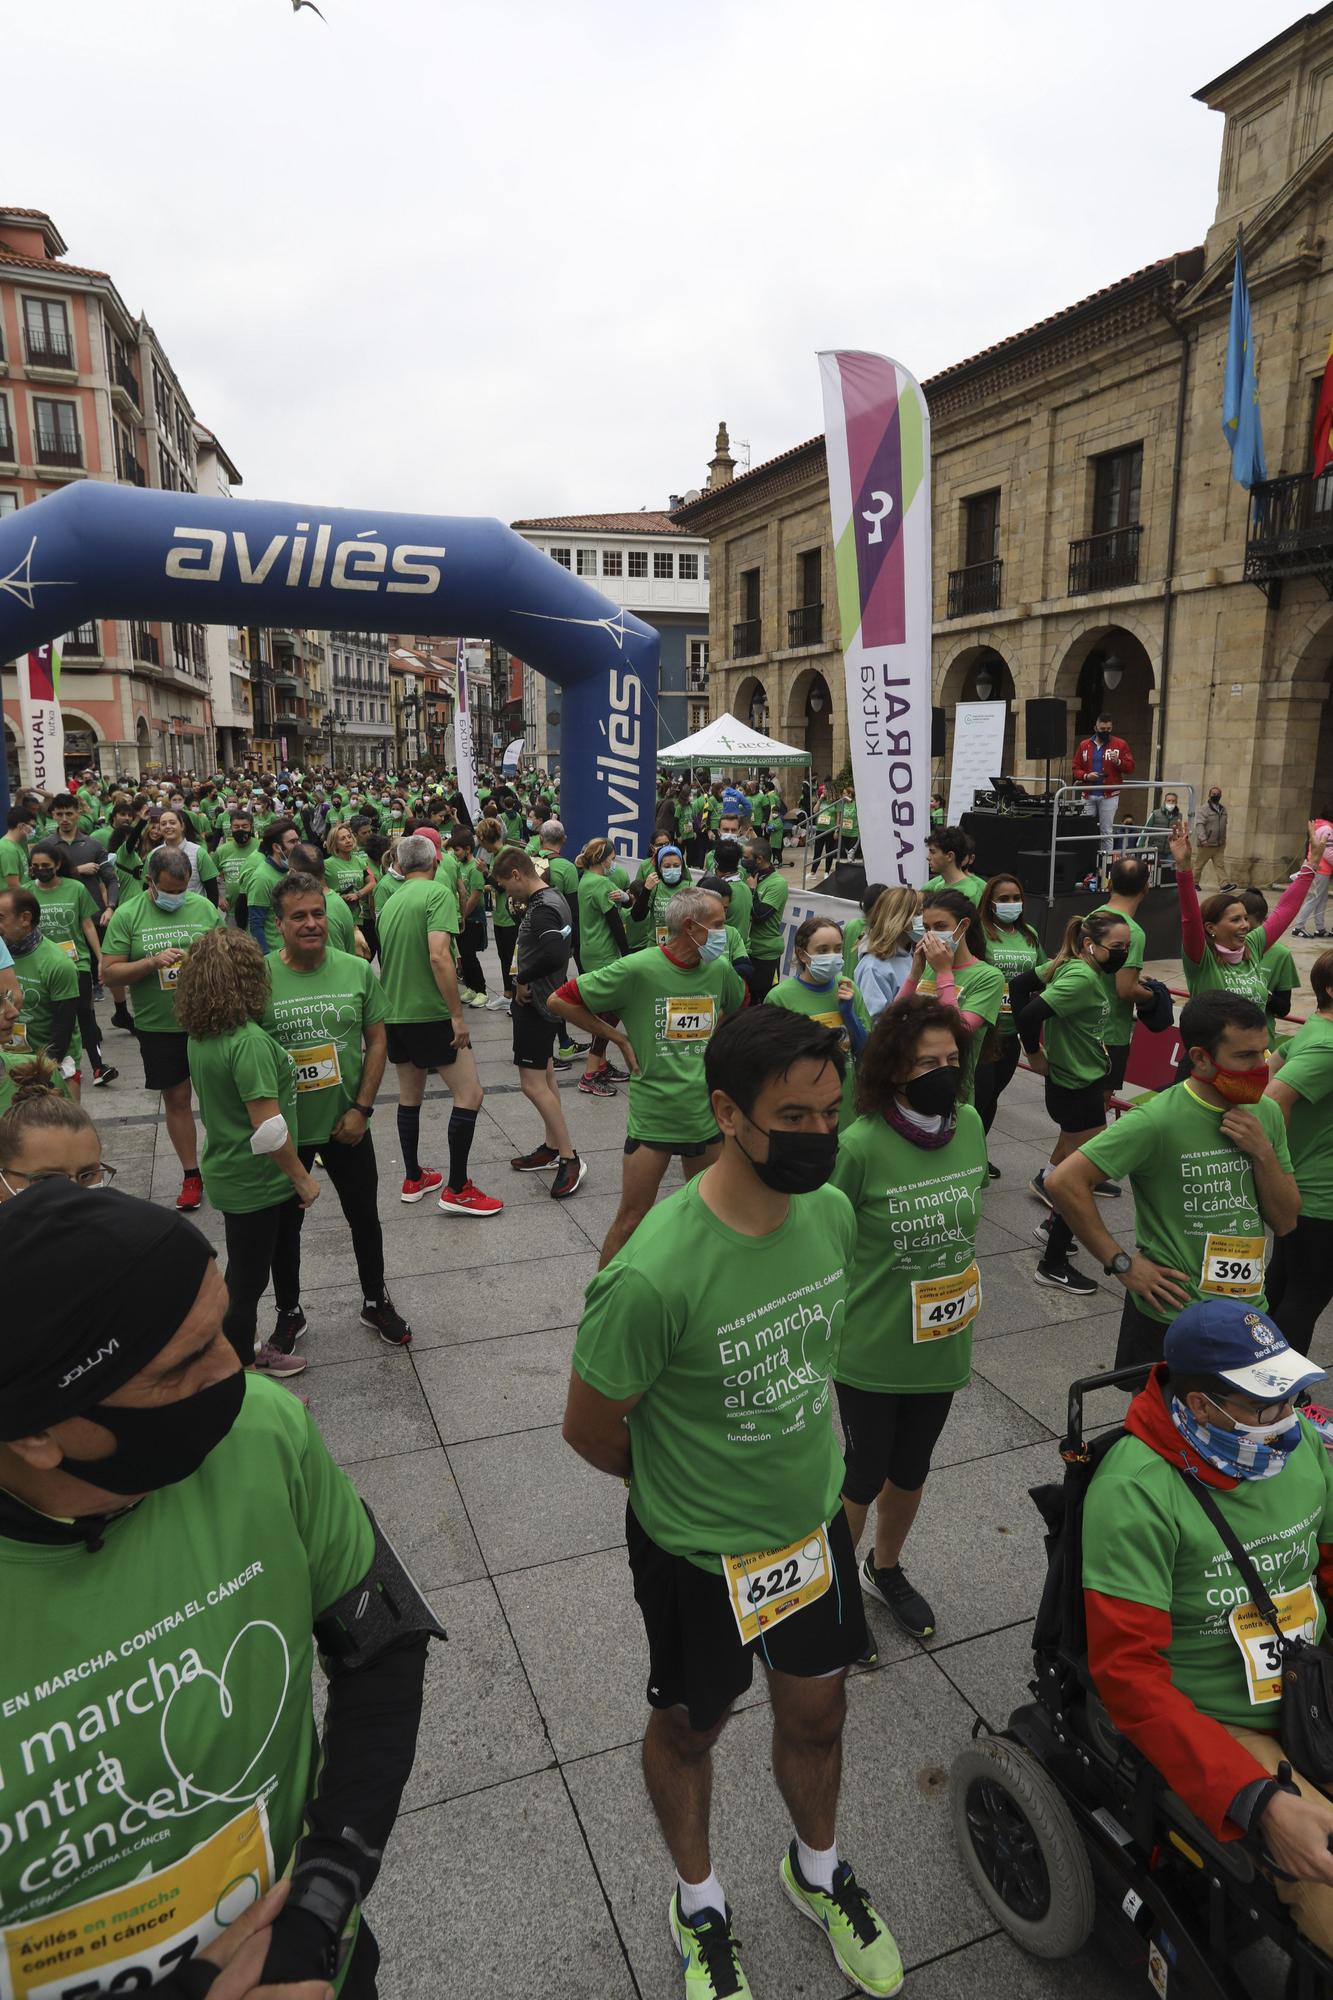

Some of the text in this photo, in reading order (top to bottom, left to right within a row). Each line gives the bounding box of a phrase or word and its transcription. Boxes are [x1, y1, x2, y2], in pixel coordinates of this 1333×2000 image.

[165, 522, 446, 594] avilés
[32, 709, 46, 790] ABORAL
[737, 741, 776, 749] aecc
[597, 668, 641, 859] avilés
[142, 930, 189, 942] En marcha
[143, 940, 173, 951] contra
[274, 1001, 335, 1020] En marcha
[677, 1016, 700, 1029] 471
[277, 1016, 313, 1031] contra
[291, 1029, 329, 1041] cáncer
[296, 1066, 319, 1080] 18
[1181, 1163, 1202, 1177] En
[886, 1185, 908, 1196] AVILÉS
[917, 1177, 941, 1188] MARCHA
[940, 1172, 961, 1182] CONTRA
[1183, 1177, 1232, 1194] contra
[889, 1184, 968, 1214] En marcha
[1183, 1194, 1248, 1212] el cáncer
[891, 1209, 945, 1233] contra
[893, 1235, 908, 1251] el
[912, 1226, 962, 1248] cáncer
[1215, 1260, 1252, 1280] 396
[717, 1268, 844, 1336] AVILÉS EN MARCHA CONTRA EL CÁNCER
[928, 1296, 966, 1323] 497
[719, 1303, 823, 1365] En marcha
[58, 1338, 120, 1388] JOLUVI
[1254, 1346, 1271, 1359] Real
[722, 1344, 789, 1388] contra
[724, 1362, 812, 1409] el cáncer
[727, 1433, 772, 1442] fundación
[758, 1551, 766, 1560] el
[1212, 1550, 1234, 1564] AVILÉ
[1242, 1533, 1280, 1552] MARCHA
[747, 1559, 801, 1604] 622
[1206, 1585, 1250, 1606] con
[1, 1560, 266, 1718] EN MARCHA CONTRA EL CÁNCER
[20, 1648, 202, 1776] marcha
[18, 1773, 195, 1893] cáncer
[81, 1853, 121, 1881] CONTRA
[121, 1845, 133, 1858] EL
[133, 1828, 171, 1852] CÁNCER
[19, 1886, 181, 1958] Avilés en marcha
[22, 1944, 85, 1974] contra
[90, 1935, 108, 1952] el
[112, 1906, 177, 1944] cáncer
